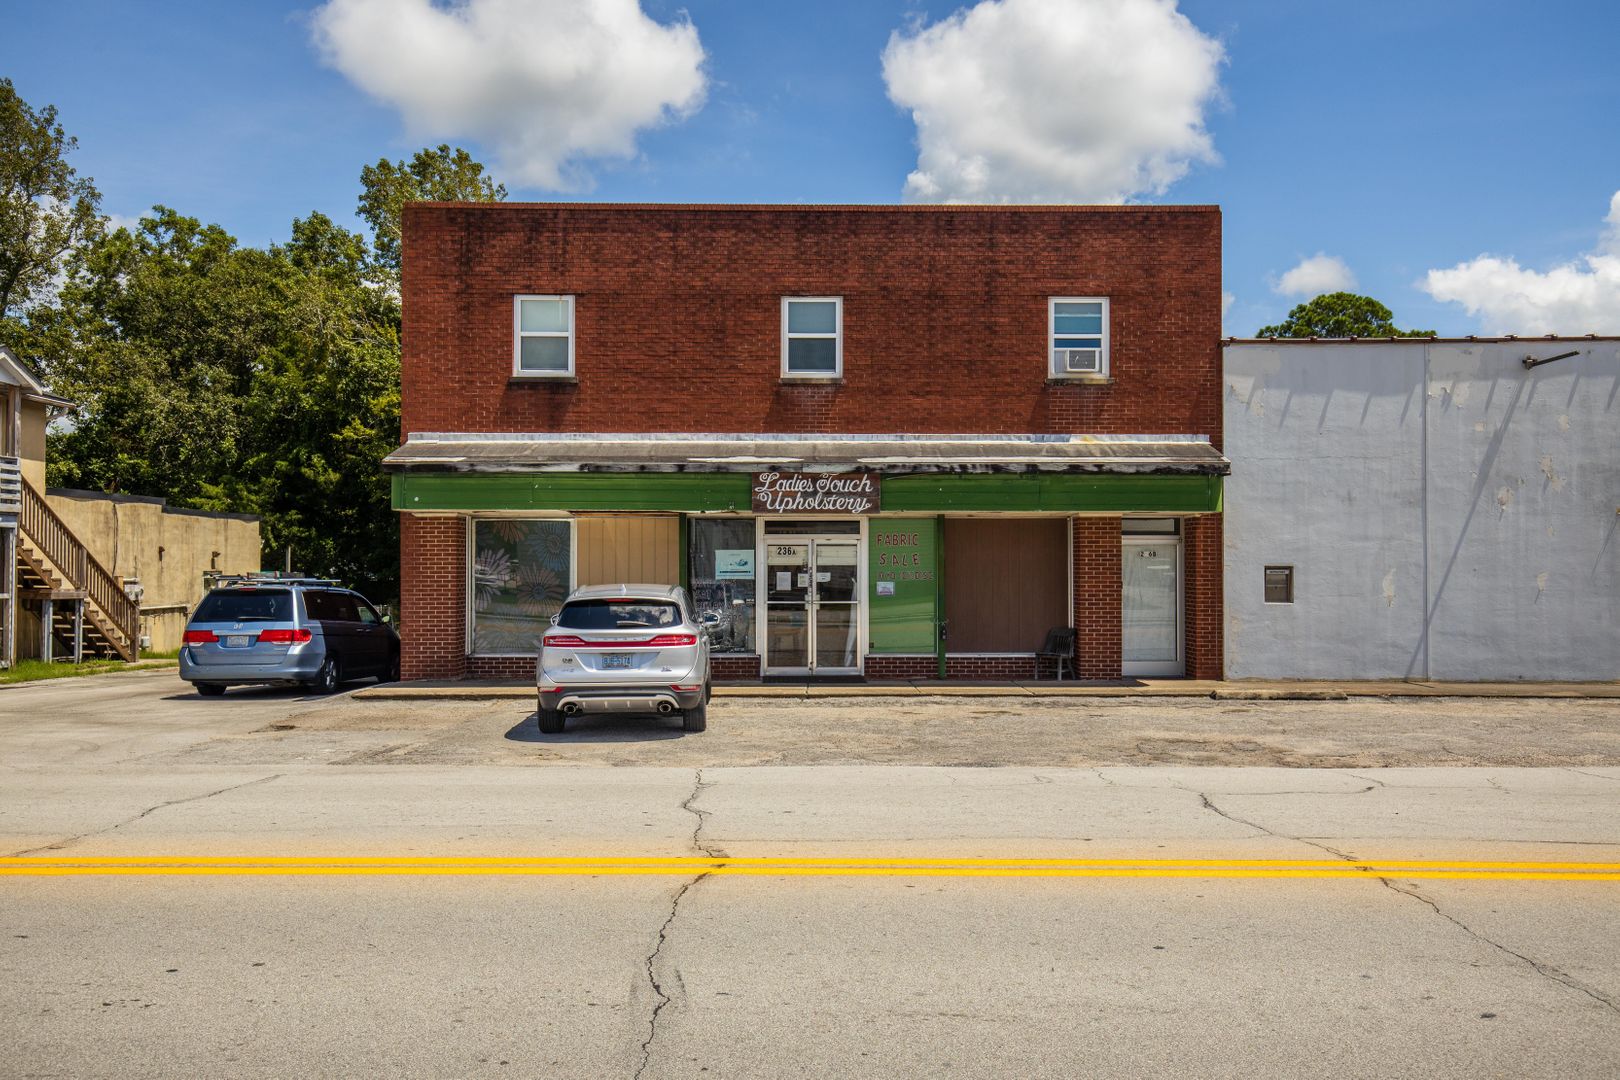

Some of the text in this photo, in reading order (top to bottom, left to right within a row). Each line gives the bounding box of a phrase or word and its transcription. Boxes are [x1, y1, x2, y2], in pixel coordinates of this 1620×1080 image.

[755, 472, 873, 492] Ladies Touch
[757, 491, 873, 513] Upholstery
[877, 532, 919, 546] FABRIC
[879, 553, 919, 567] SALE
